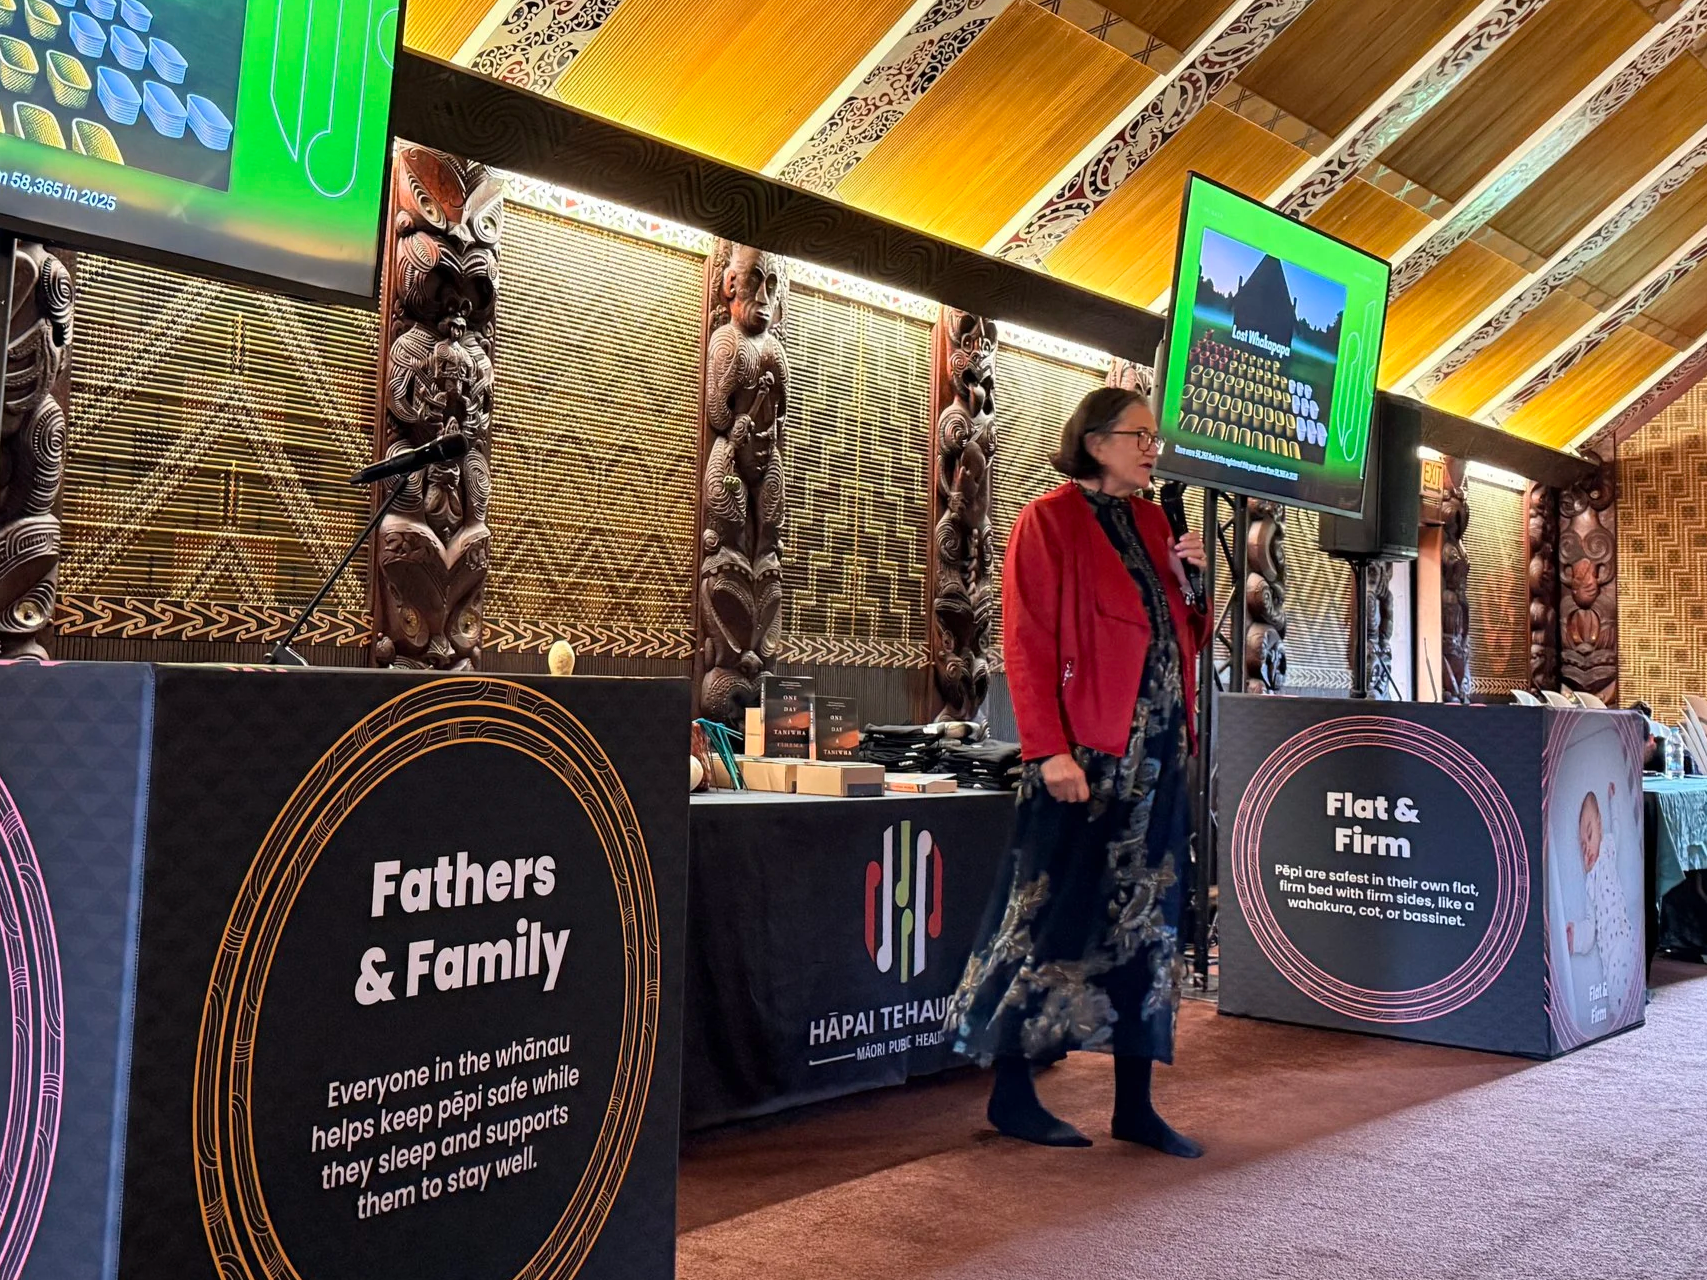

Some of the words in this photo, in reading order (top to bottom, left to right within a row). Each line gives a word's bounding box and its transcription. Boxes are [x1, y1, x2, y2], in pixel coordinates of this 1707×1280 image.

[10, 172, 63, 198] 58,365
[64, 184, 78, 202] in
[79, 189, 116, 210] 2025
[1232, 324, 1248, 342] Lost
[1249, 330, 1290, 358] Whakapapa
[1424, 462, 1442, 487] EXIT
[1327, 792, 1388, 820] Flat
[1394, 797, 1420, 823] &
[1336, 825, 1410, 858] Firm
[371, 851, 556, 918] Fathers
[1275, 864, 1302, 880] Pēpi
[1304, 868, 1326, 880] are
[1328, 870, 1370, 885] safest
[1372, 874, 1384, 886] in
[1387, 875, 1418, 890] their
[1420, 882, 1450, 892] own
[1452, 881, 1480, 897] flat,
[1279, 880, 1306, 894] firm
[1308, 882, 1333, 896] bed
[1336, 886, 1364, 900] with
[1366, 888, 1394, 903] firm
[1396, 892, 1436, 909] sides,
[1438, 896, 1462, 910] like
[1464, 902, 1474, 912] a
[1288, 898, 1356, 916] wahakura,
[1359, 906, 1384, 920] cot,
[1386, 909, 1400, 920] or
[1403, 908, 1466, 927] bassinet.
[354, 947, 396, 1006] &
[405, 917, 571, 998] Family
[809, 1010, 874, 1046] HĀPAI
[856, 1042, 886, 1061] MĀORI
[327, 1066, 430, 1108] Everyone
[434, 1056, 453, 1083] in
[458, 1050, 490, 1077] the
[495, 1034, 571, 1068] whānau
[311, 1118, 374, 1152] helps
[380, 1103, 433, 1134] keep
[438, 1084, 483, 1128] pēpi
[487, 1076, 528, 1108] safe
[532, 1064, 580, 1096] while
[321, 1156, 374, 1190] they
[378, 1144, 436, 1171] sleep
[440, 1122, 482, 1156] and
[486, 1104, 569, 1146] supports
[357, 1184, 416, 1220] them
[421, 1176, 442, 1200] to
[447, 1162, 492, 1192] stay
[495, 1146, 538, 1179] well.
